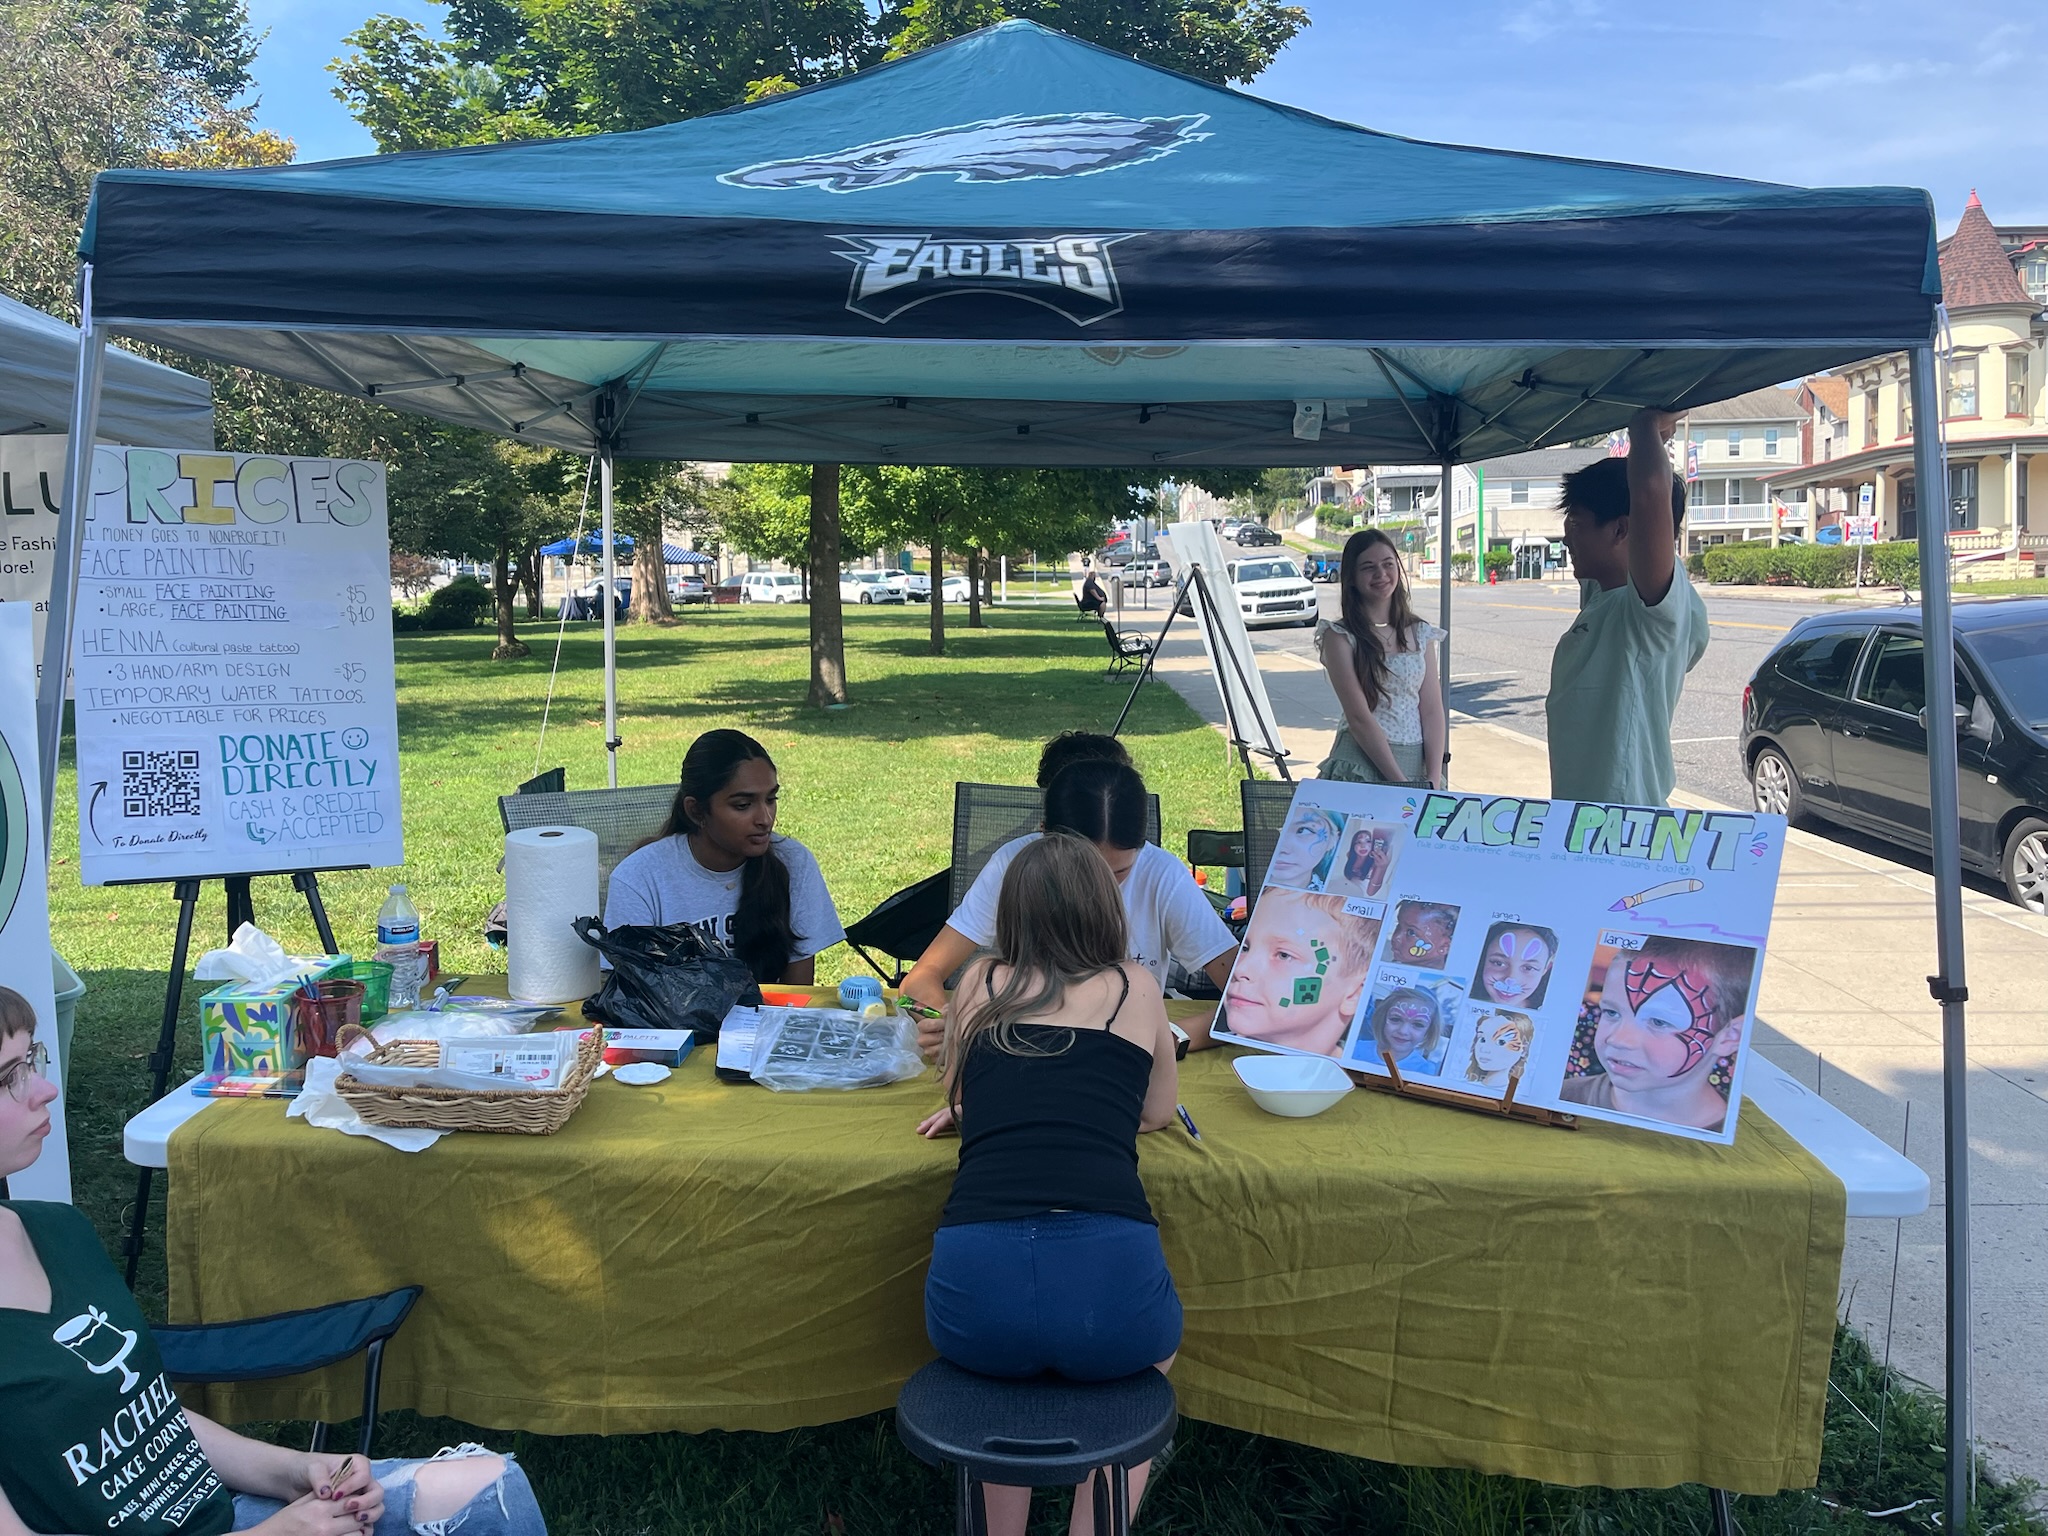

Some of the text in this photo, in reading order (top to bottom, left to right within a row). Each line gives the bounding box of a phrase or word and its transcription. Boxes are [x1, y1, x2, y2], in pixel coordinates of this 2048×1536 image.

[850, 236, 1122, 307] EAGLES
[85, 448, 378, 527] PRICES
[12, 536, 56, 551] Fashi
[102, 527, 143, 543] MONEY
[151, 529, 179, 544] GOES
[187, 529, 200, 543] TO
[209, 530, 287, 545] NONPROFIT!
[0, 560, 35, 574] ore!
[144, 548, 254, 577] PAINTING
[105, 585, 147, 599] SMALL
[156, 584, 190, 600] FACE
[200, 585, 275, 601] PAINTING
[171, 603, 204, 620] FACE
[215, 604, 288, 621] PAINTING
[82, 629, 167, 654] HENNA
[223, 640, 252, 656] paste
[116, 663, 127, 681] 3
[226, 662, 291, 679] DESIGN
[83, 685, 211, 708] TEMPORARY
[222, 684, 277, 702] WATER
[120, 708, 327, 726] NEGOTIABLE FOR PRICES
[219, 730, 336, 764] DONATE
[222, 759, 377, 796] DIRECTLY
[229, 790, 381, 821] CASH & CREDIT
[112, 828, 208, 848] To Donate Directly
[278, 812, 384, 842] ACCEPTED
[1414, 794, 1756, 872] FACE PAINT
[1508, 849, 1542, 862] designs
[1550, 852, 1567, 861] and
[1602, 932, 1639, 949] large
[62, 1371, 177, 1487] RACHEL
[100, 1411, 190, 1501] CAKE CORNE
[178, 1456, 202, 1481] BARS
[139, 1477, 161, 1501] MINI
